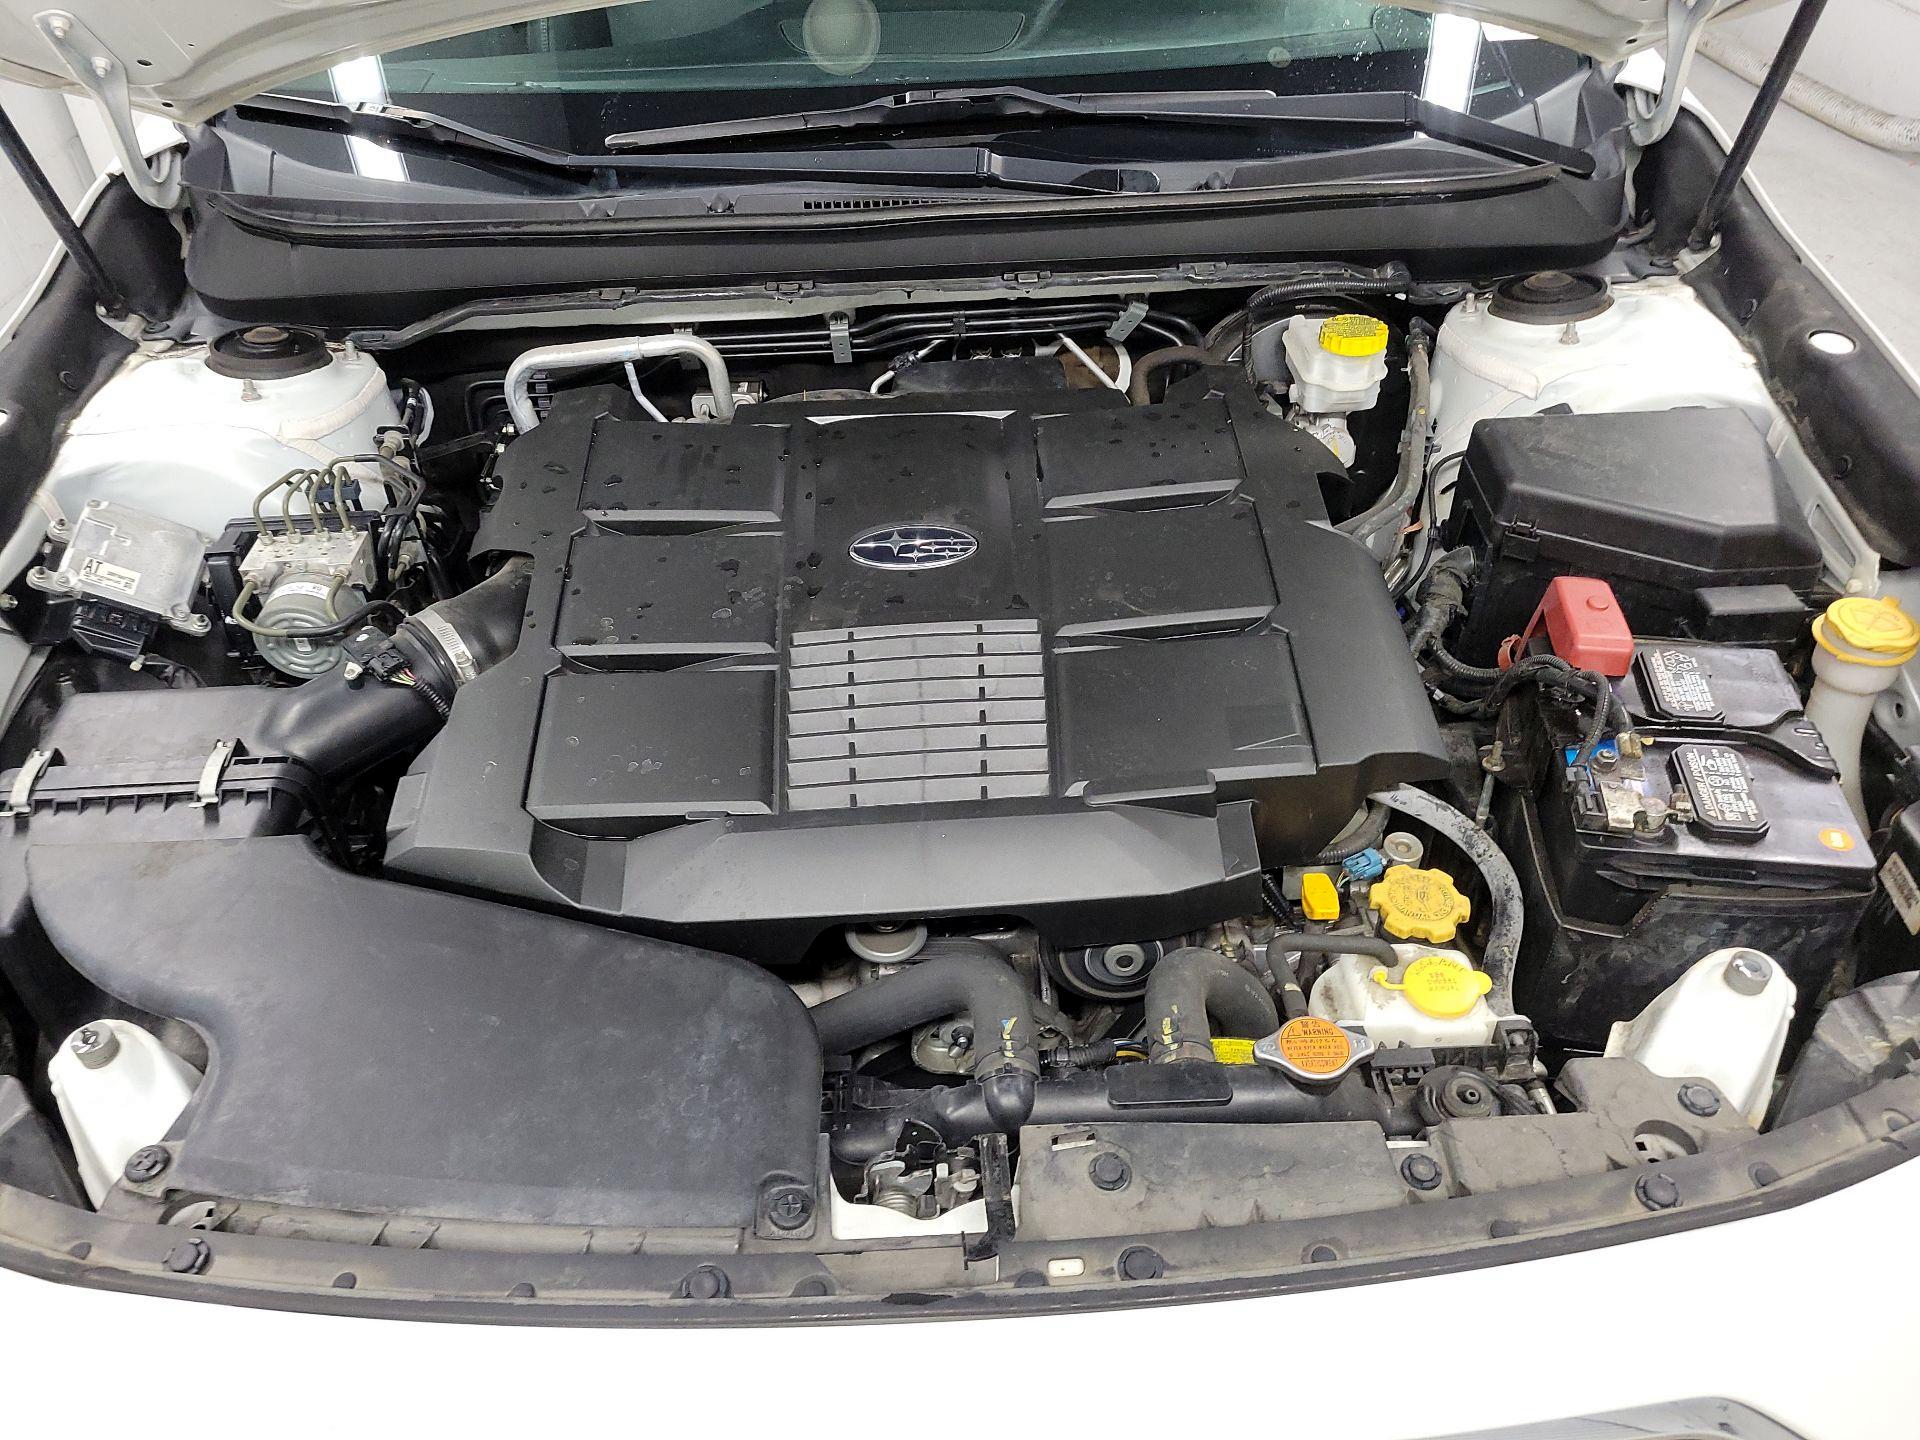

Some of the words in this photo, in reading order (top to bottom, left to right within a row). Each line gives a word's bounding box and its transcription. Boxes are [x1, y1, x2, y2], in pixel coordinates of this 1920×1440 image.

[84, 559, 103, 574] AT
[1685, 751, 1703, 778] POISON
[1696, 780, 1715, 812] DANGER
[1302, 1027, 1334, 1037] WARNING
